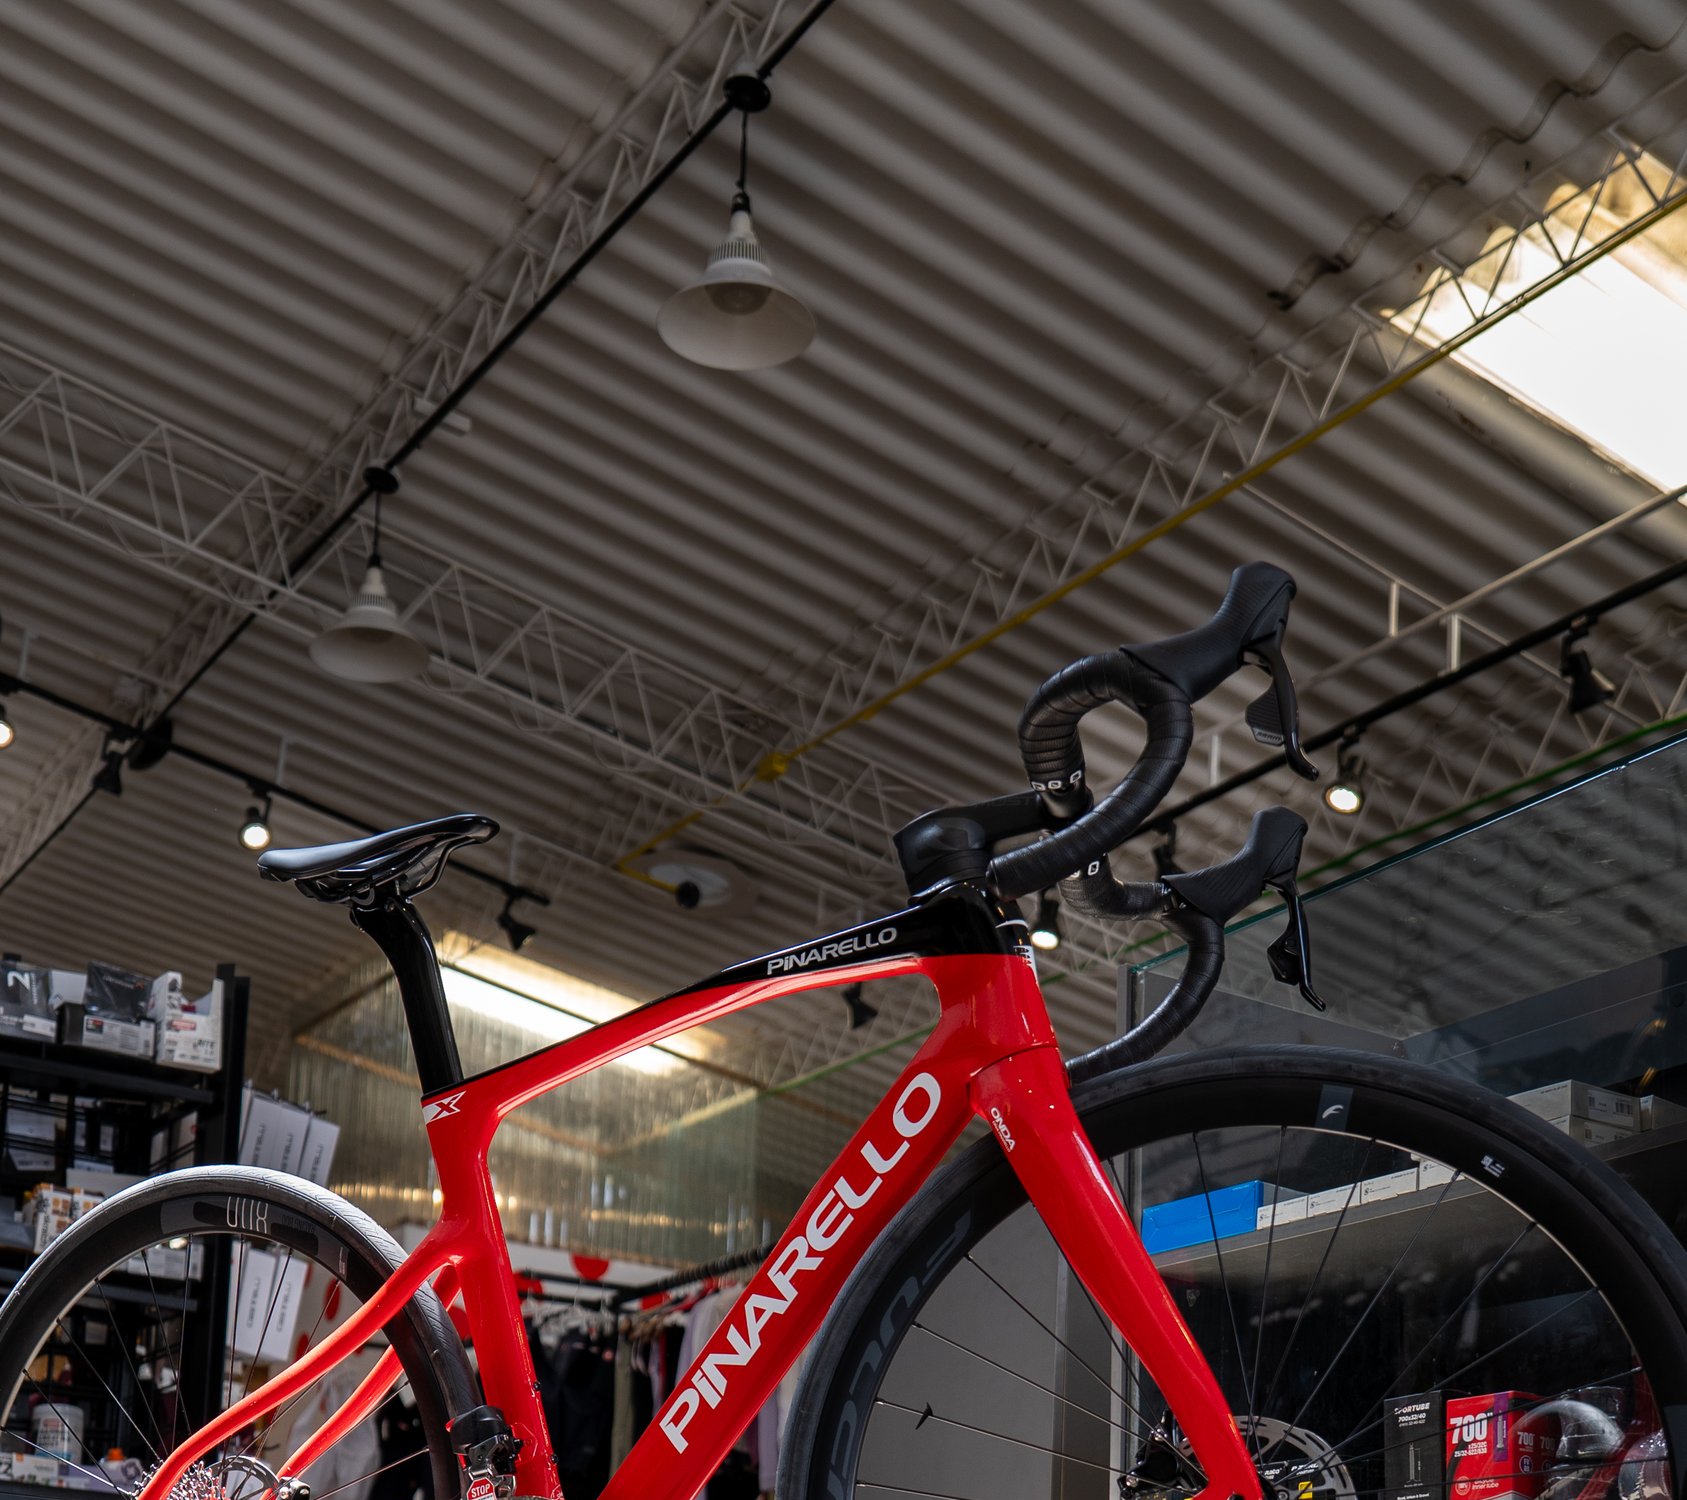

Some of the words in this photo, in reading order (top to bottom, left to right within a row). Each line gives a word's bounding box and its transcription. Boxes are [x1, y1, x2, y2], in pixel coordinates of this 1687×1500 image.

[767, 927, 897, 975] PINARELLO
[991, 1107, 1015, 1150] ONDA
[659, 1072, 941, 1454] PINARELLO
[471, 1483, 491, 1498] STOP
